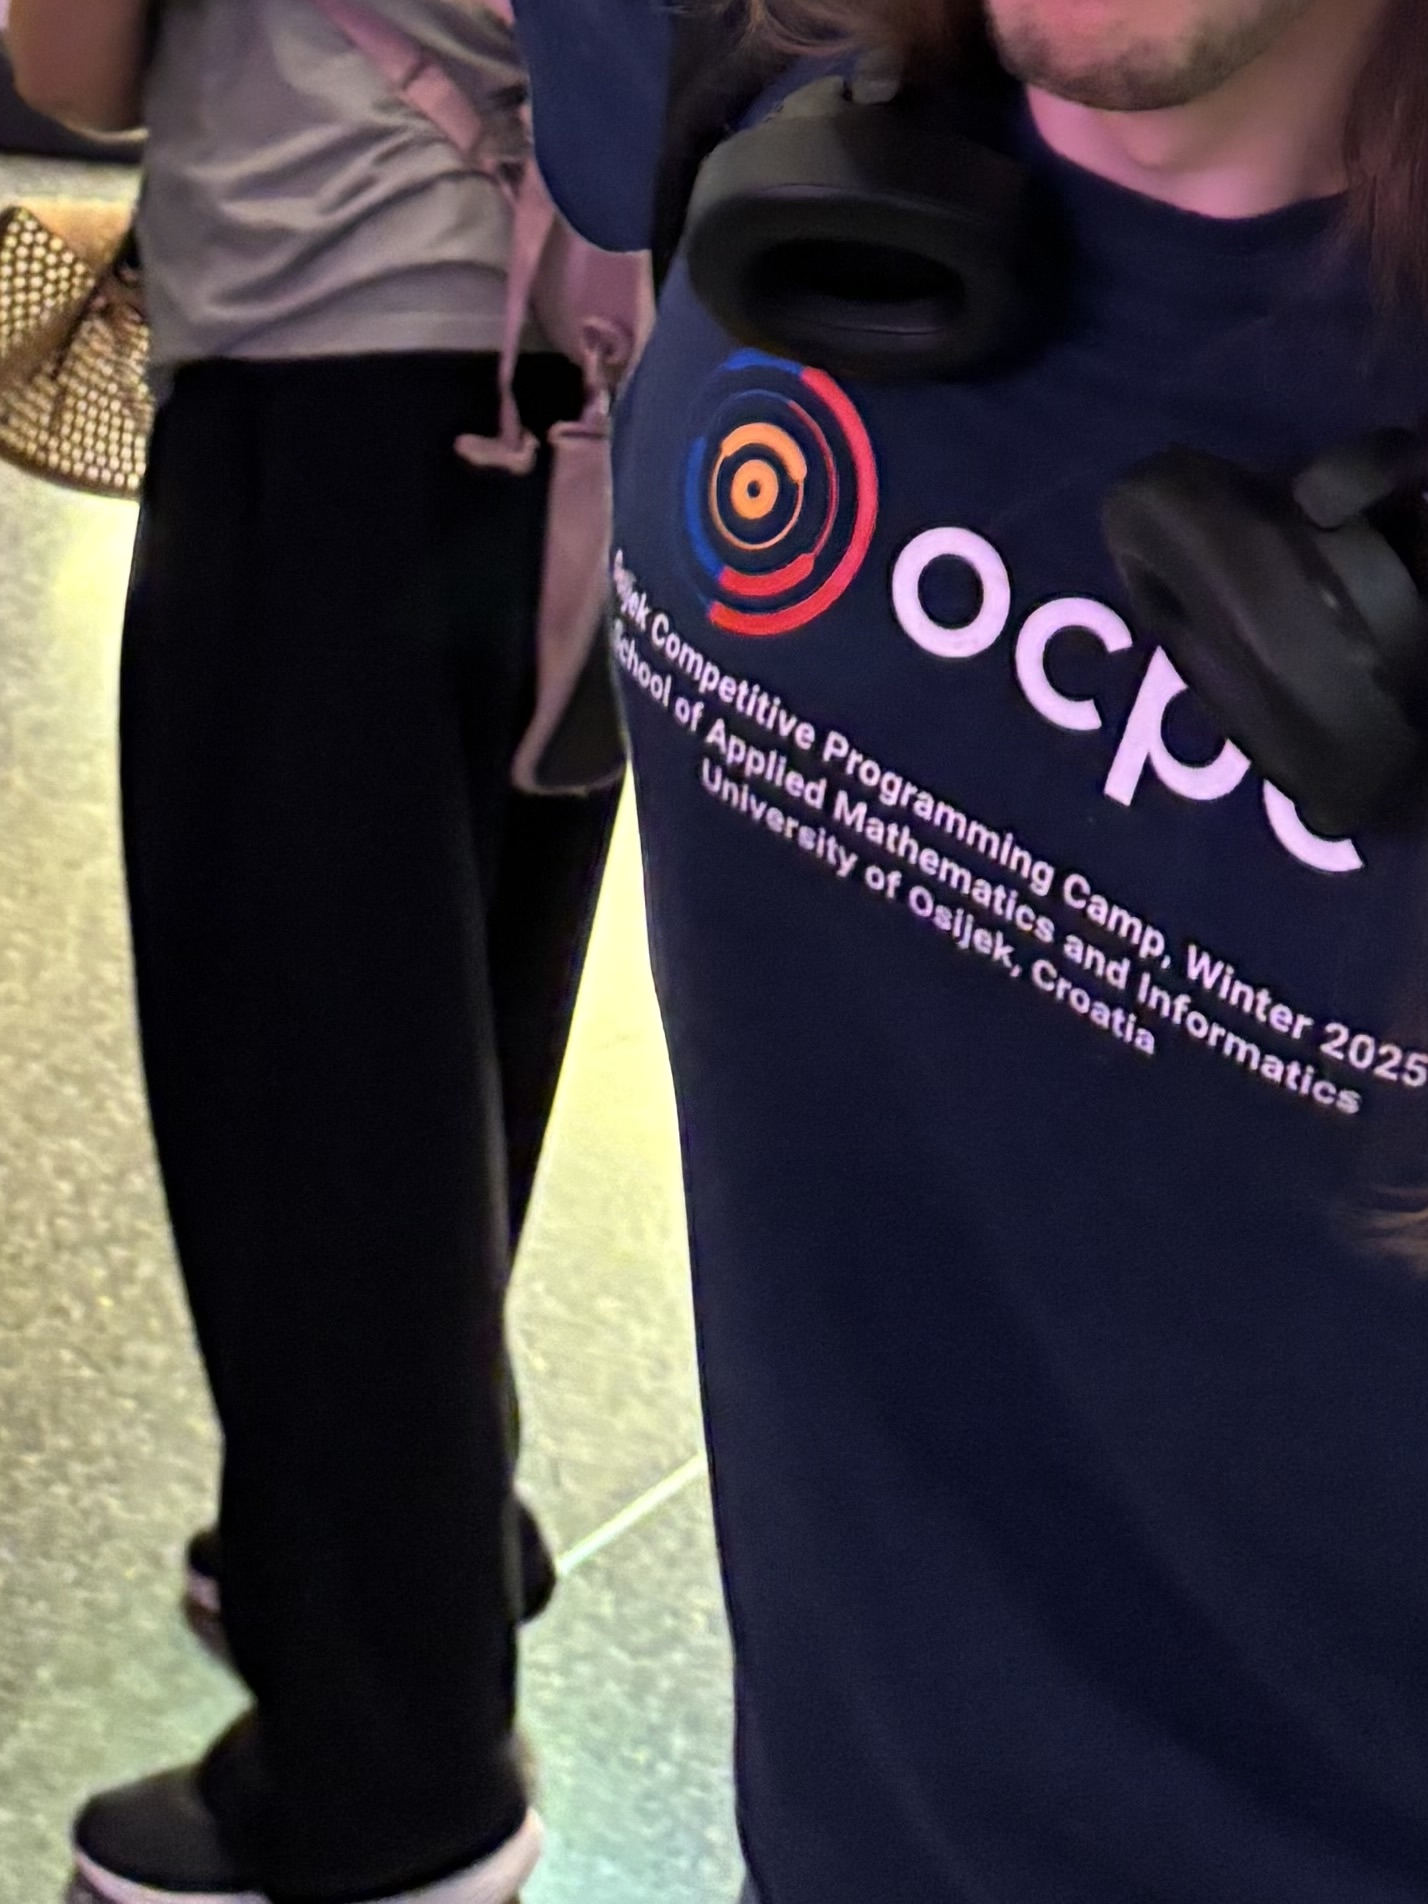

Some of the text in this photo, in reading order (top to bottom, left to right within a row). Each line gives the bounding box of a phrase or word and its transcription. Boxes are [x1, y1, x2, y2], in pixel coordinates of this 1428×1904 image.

[651, 613, 815, 750] Competitive
[823, 730, 1055, 897] Programming
[1063, 873, 1171, 969] Camp,
[1186, 943, 1314, 1040] Winter
[675, 696, 704, 733] of
[705, 718, 827, 810] Applied
[833, 790, 1056, 943] Mathematics
[1063, 934, 1131, 991] and
[1138, 971, 1362, 1115] Informatics
[702, 757, 1156, 1056] University of Osijek, Croatia
